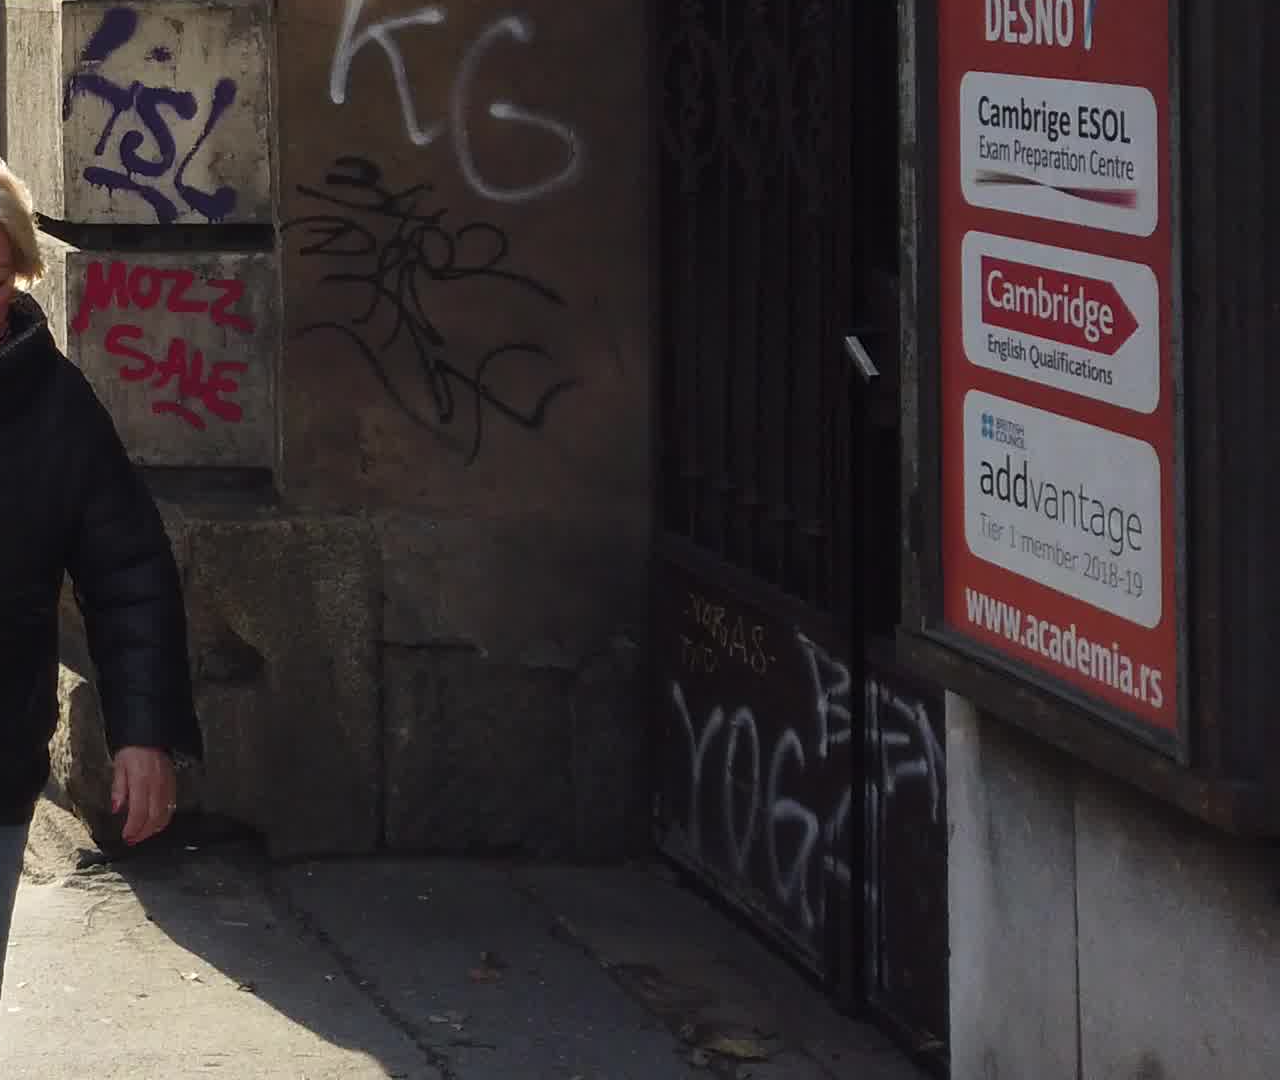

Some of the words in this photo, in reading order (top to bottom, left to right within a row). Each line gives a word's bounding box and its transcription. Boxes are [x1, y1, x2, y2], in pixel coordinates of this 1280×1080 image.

[978, 95, 1071, 140] Cambrige
[1078, 106, 1131, 144] ESOL
[979, 135, 1010, 161] Exam
[1014, 138, 1086, 173] Preparation
[1090, 150, 1134, 180] Centre
[986, 269, 1114, 342] Cambridge
[988, 333, 1027, 364] English
[1029, 345, 1113, 386] Qualifications
[980, 455, 1142, 556] addvantage
[980, 513, 1004, 542] Tier
[1009, 526, 1016, 550] 1
[1021, 537, 1078, 572] member
[1083, 552, 1144, 598] 2018-19
[965, 587, 1164, 709] www.academia.rs
